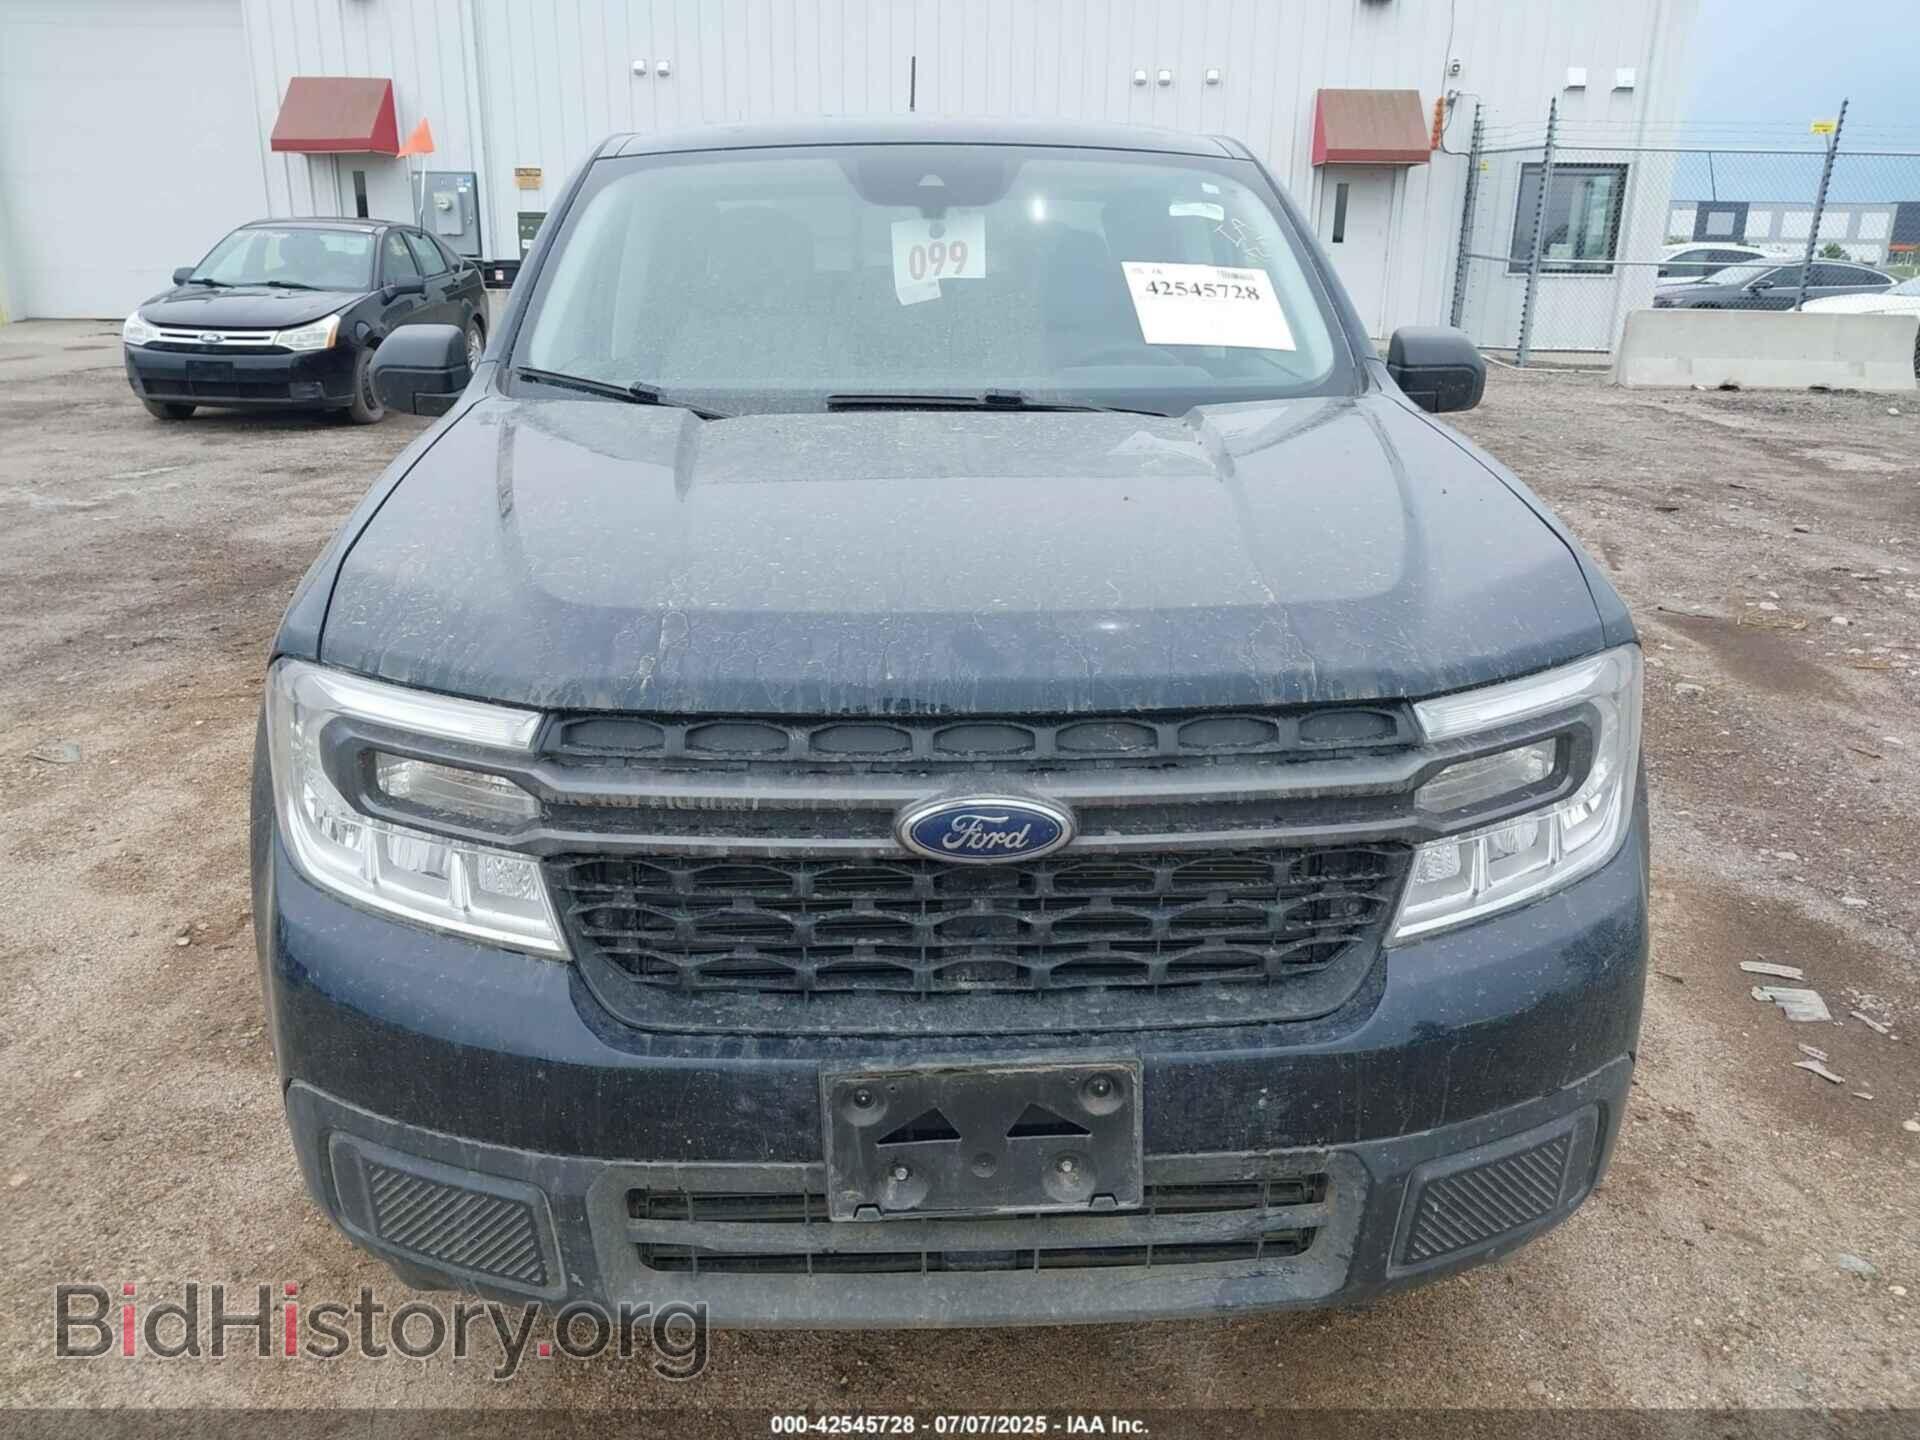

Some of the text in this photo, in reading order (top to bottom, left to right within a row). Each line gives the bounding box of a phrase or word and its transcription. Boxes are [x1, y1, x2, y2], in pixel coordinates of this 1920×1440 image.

[908, 240, 969, 281] 099
[1145, 280, 1261, 301] 42545728
[941, 813, 1032, 850] Ford
